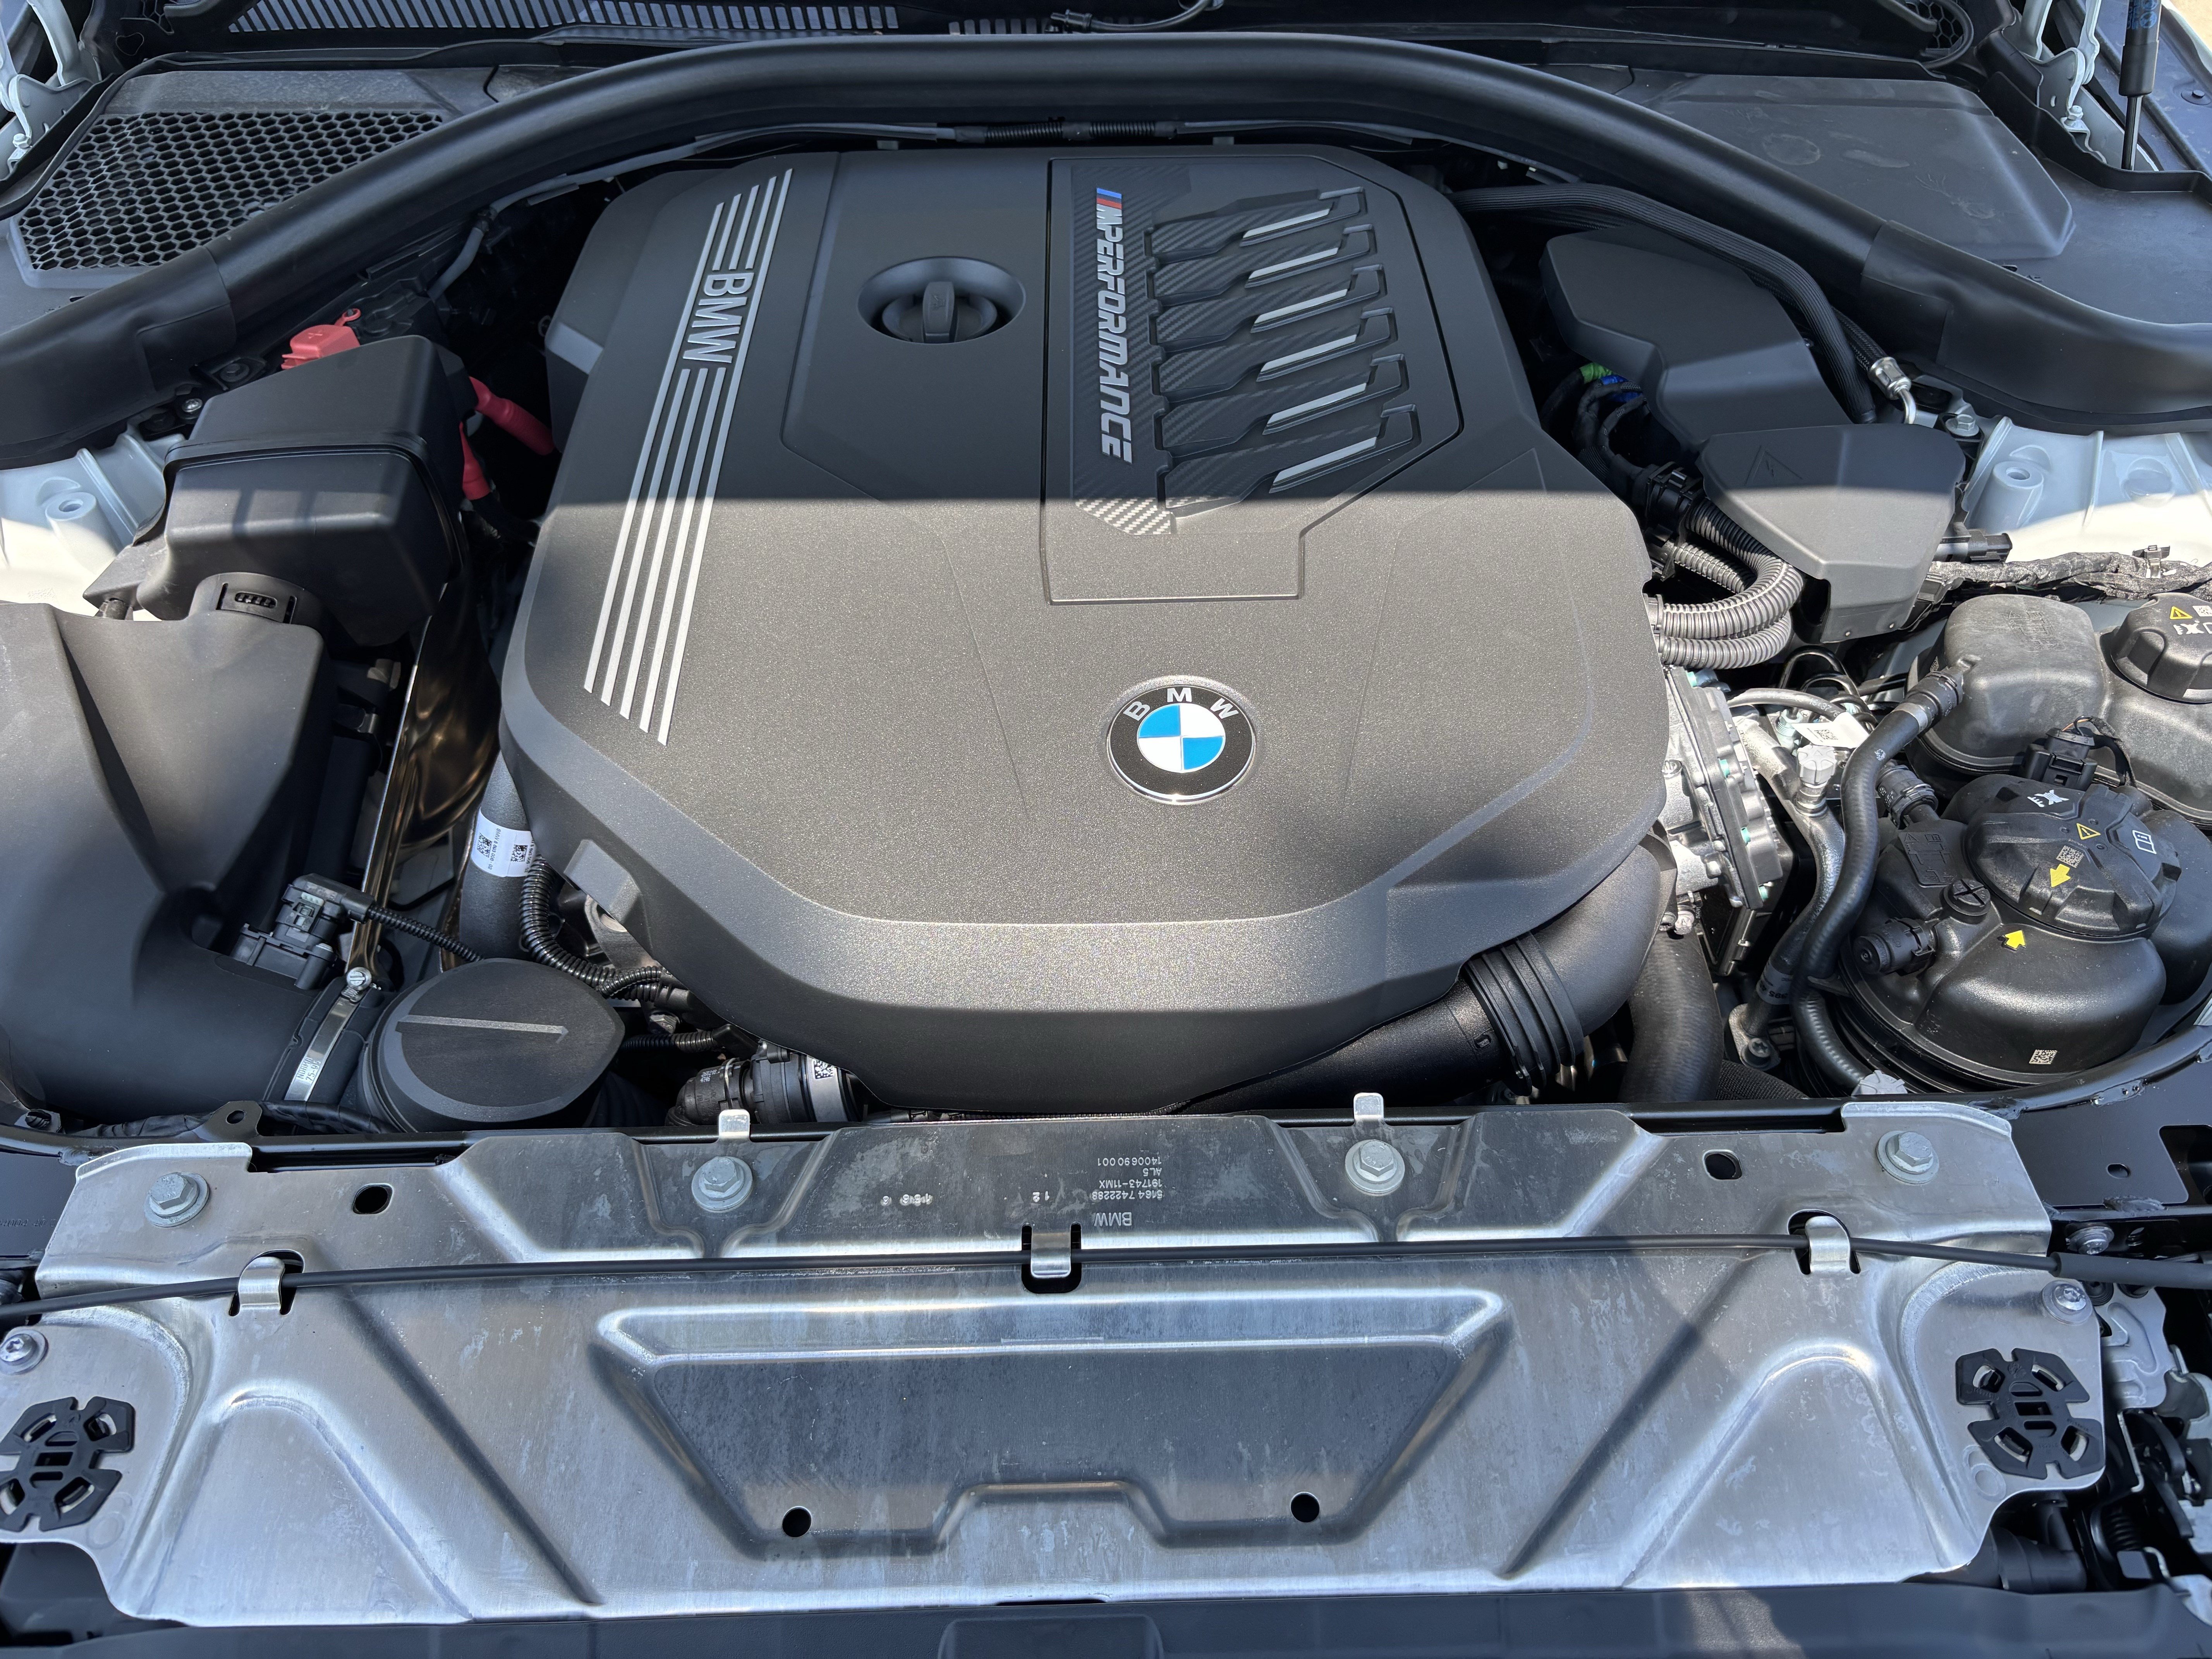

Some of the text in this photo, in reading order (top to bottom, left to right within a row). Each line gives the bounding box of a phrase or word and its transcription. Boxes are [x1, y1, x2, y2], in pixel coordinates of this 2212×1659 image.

[683, 272, 754, 363] BMW
[1123, 687, 1239, 721] BMW
[1142, 1167, 1163, 1176] AL5
[1099, 1178, 1163, 1189] 191743-11MX
[1091, 1190, 1163, 1200] 5164 7422288
[1094, 1212, 1132, 1226] BMW
